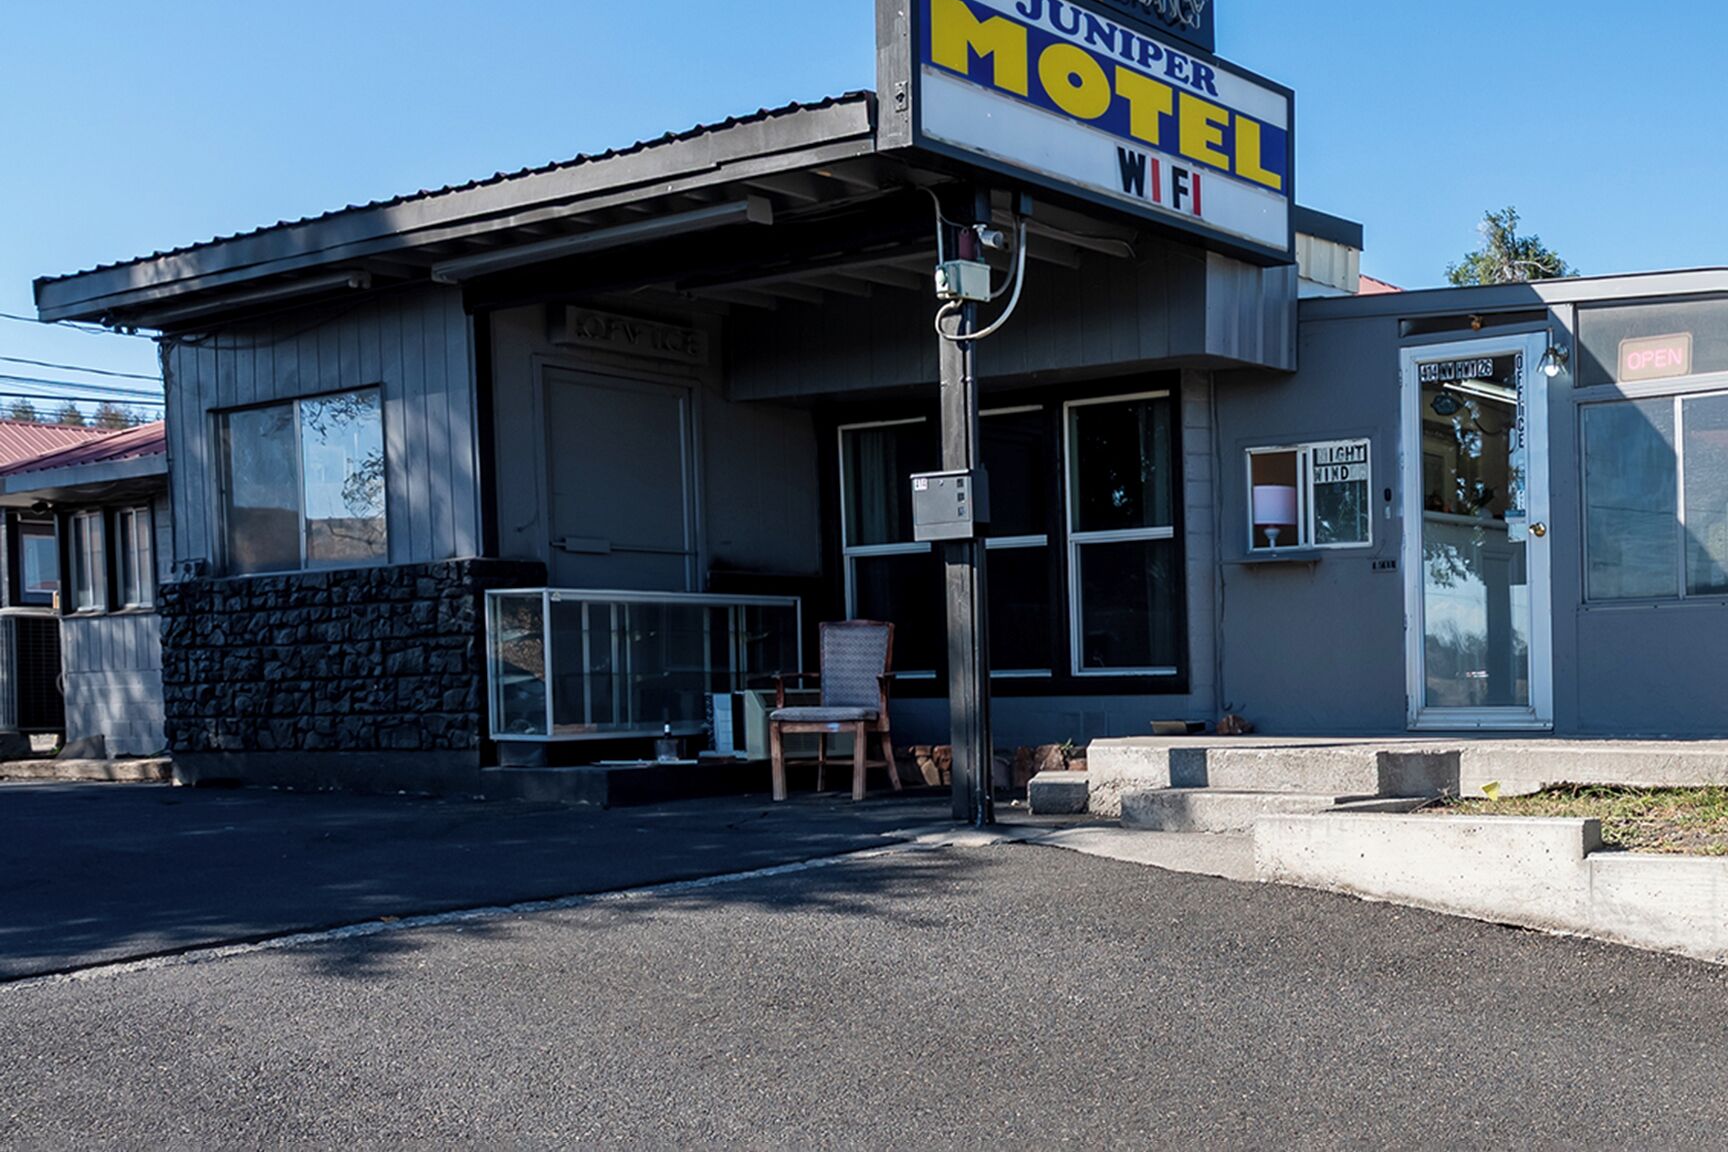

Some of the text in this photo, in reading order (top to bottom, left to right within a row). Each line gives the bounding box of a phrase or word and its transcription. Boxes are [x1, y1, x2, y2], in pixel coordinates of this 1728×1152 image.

[1478, 358, 1494, 377] 26
[1627, 348, 1682, 370] OPEN
[1515, 355, 1525, 448] OFFICE
[1318, 445, 1364, 463] IGHT
